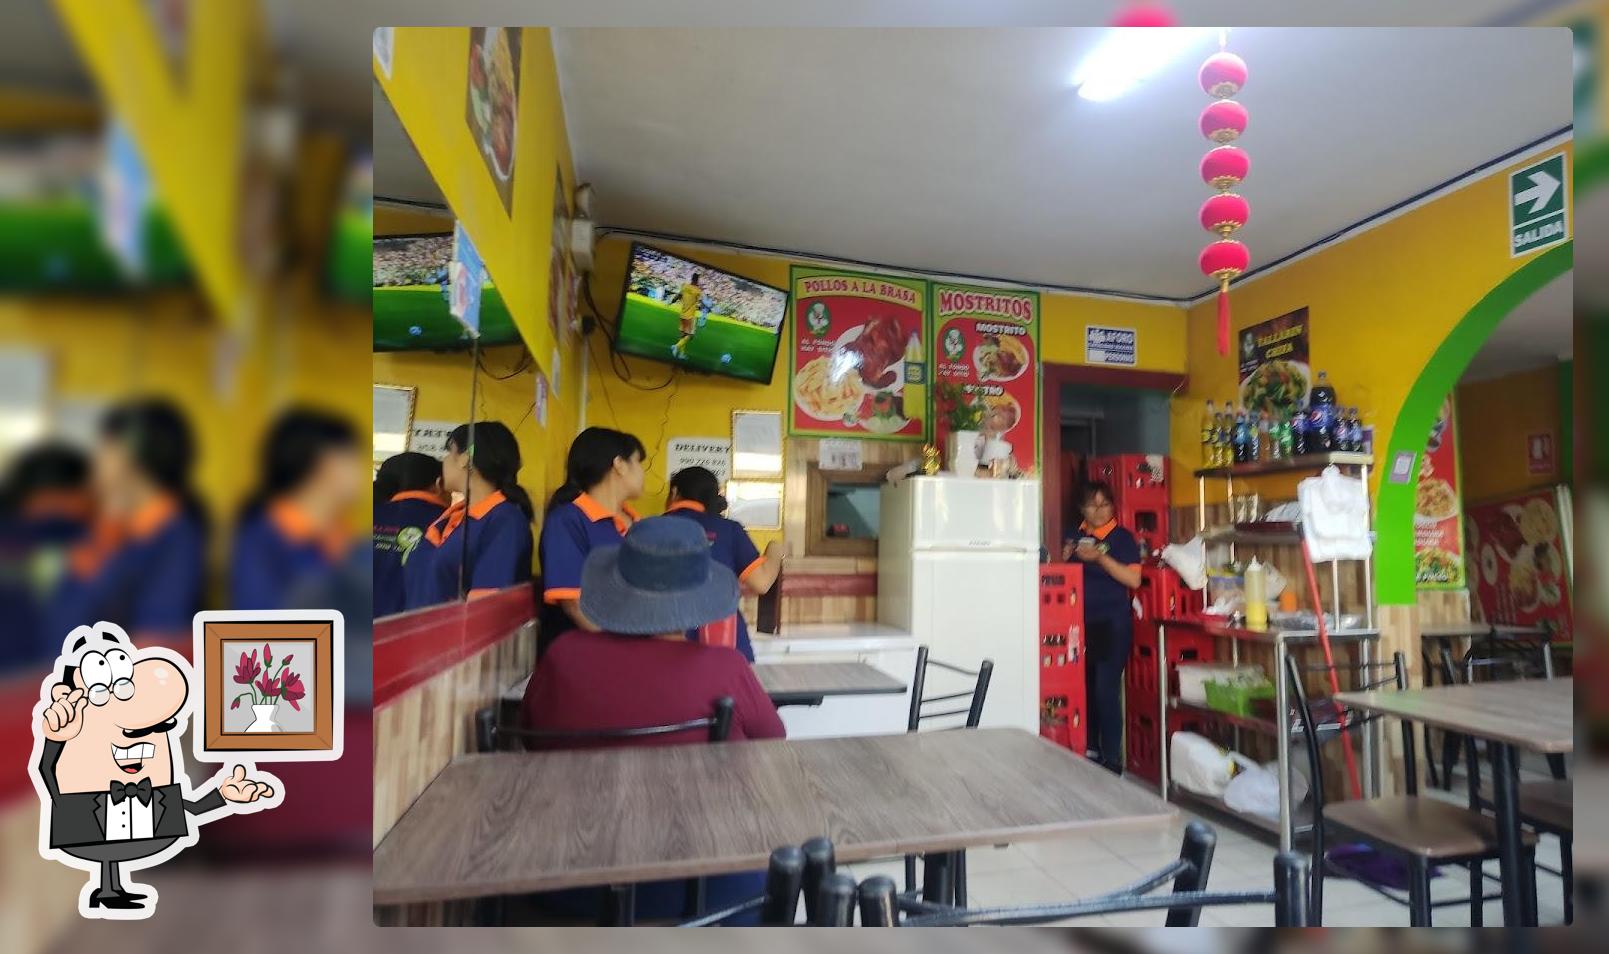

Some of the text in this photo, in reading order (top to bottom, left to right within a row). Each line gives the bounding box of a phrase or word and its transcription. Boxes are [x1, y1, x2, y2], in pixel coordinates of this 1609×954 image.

[1513, 220, 1563, 248] SALIDA
[804, 279, 916, 304] POLLOS A LA BRASA
[939, 290, 1032, 321] MOSTRITOS
[975, 322, 1027, 336] MOSTRITO
[675, 443, 730, 454] DELIVERY
